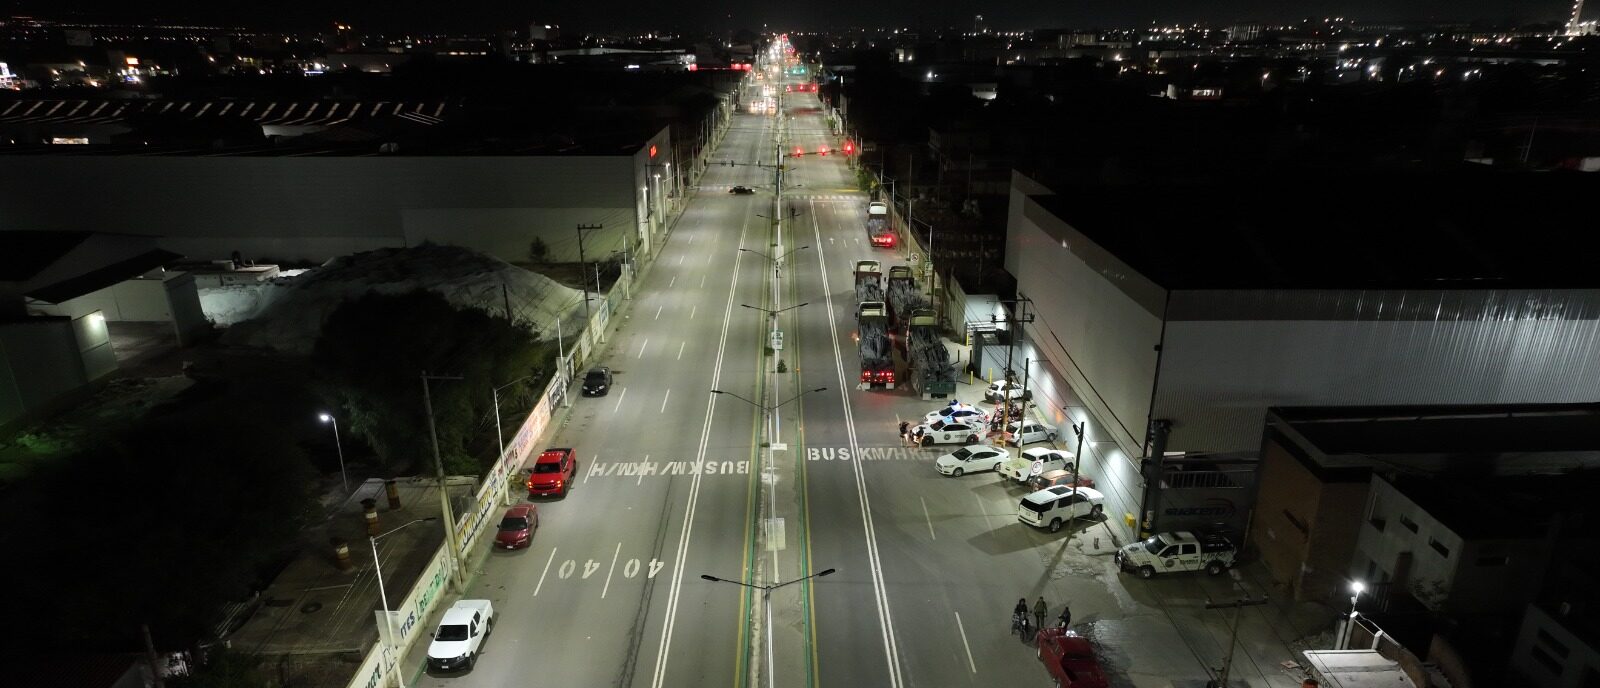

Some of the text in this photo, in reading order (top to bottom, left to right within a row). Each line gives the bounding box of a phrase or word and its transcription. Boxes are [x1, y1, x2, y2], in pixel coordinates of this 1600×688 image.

[808, 447, 850, 461] BUS
[859, 447, 907, 461] KM/H
[590, 461, 749, 477] BUS KM/H KM/H
[559, 559, 600, 579] 40
[624, 559, 664, 579] 40
